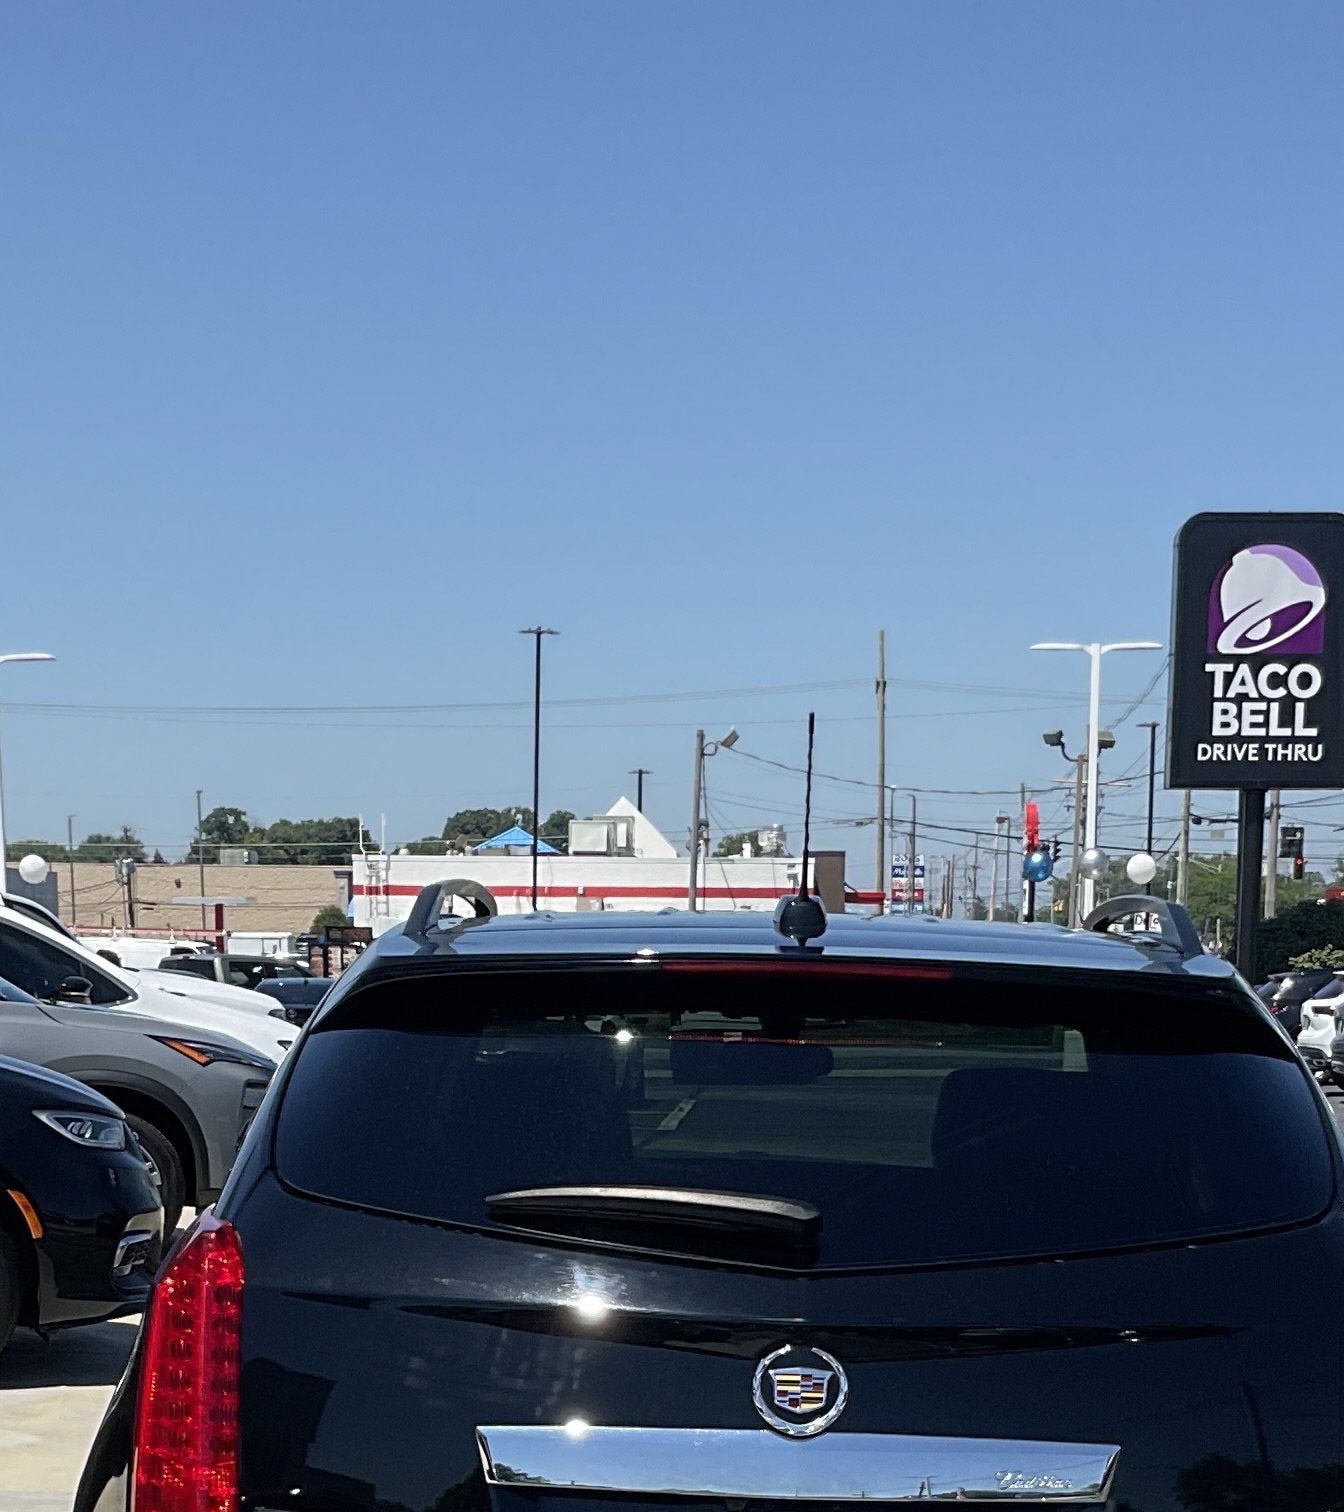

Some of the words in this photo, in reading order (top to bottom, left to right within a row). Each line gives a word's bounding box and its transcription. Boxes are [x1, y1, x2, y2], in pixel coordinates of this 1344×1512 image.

[1205, 663, 1322, 699] TACO
[1211, 702, 1318, 737] BELL
[1197, 743, 1260, 761] DRIVE
[1264, 743, 1324, 762] THRU
